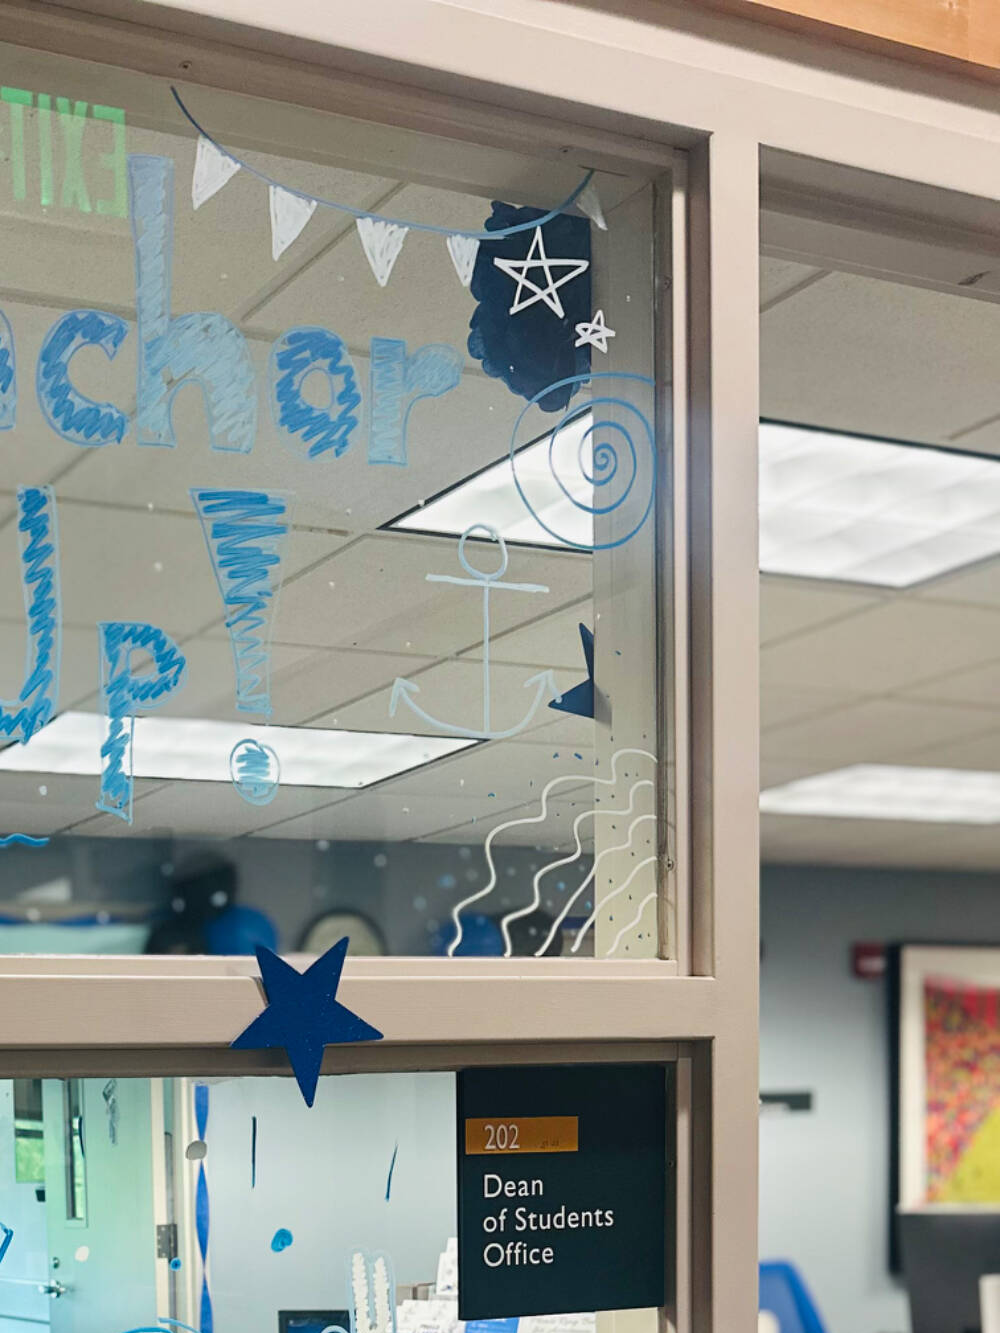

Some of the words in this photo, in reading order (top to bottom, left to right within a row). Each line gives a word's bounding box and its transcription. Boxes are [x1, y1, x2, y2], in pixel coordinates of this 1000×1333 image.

[484, 1124, 520, 1150] 202
[484, 1173, 543, 1198] Dean
[483, 1208, 508, 1233] of
[515, 1205, 614, 1231] Students
[483, 1241, 554, 1267] Office
